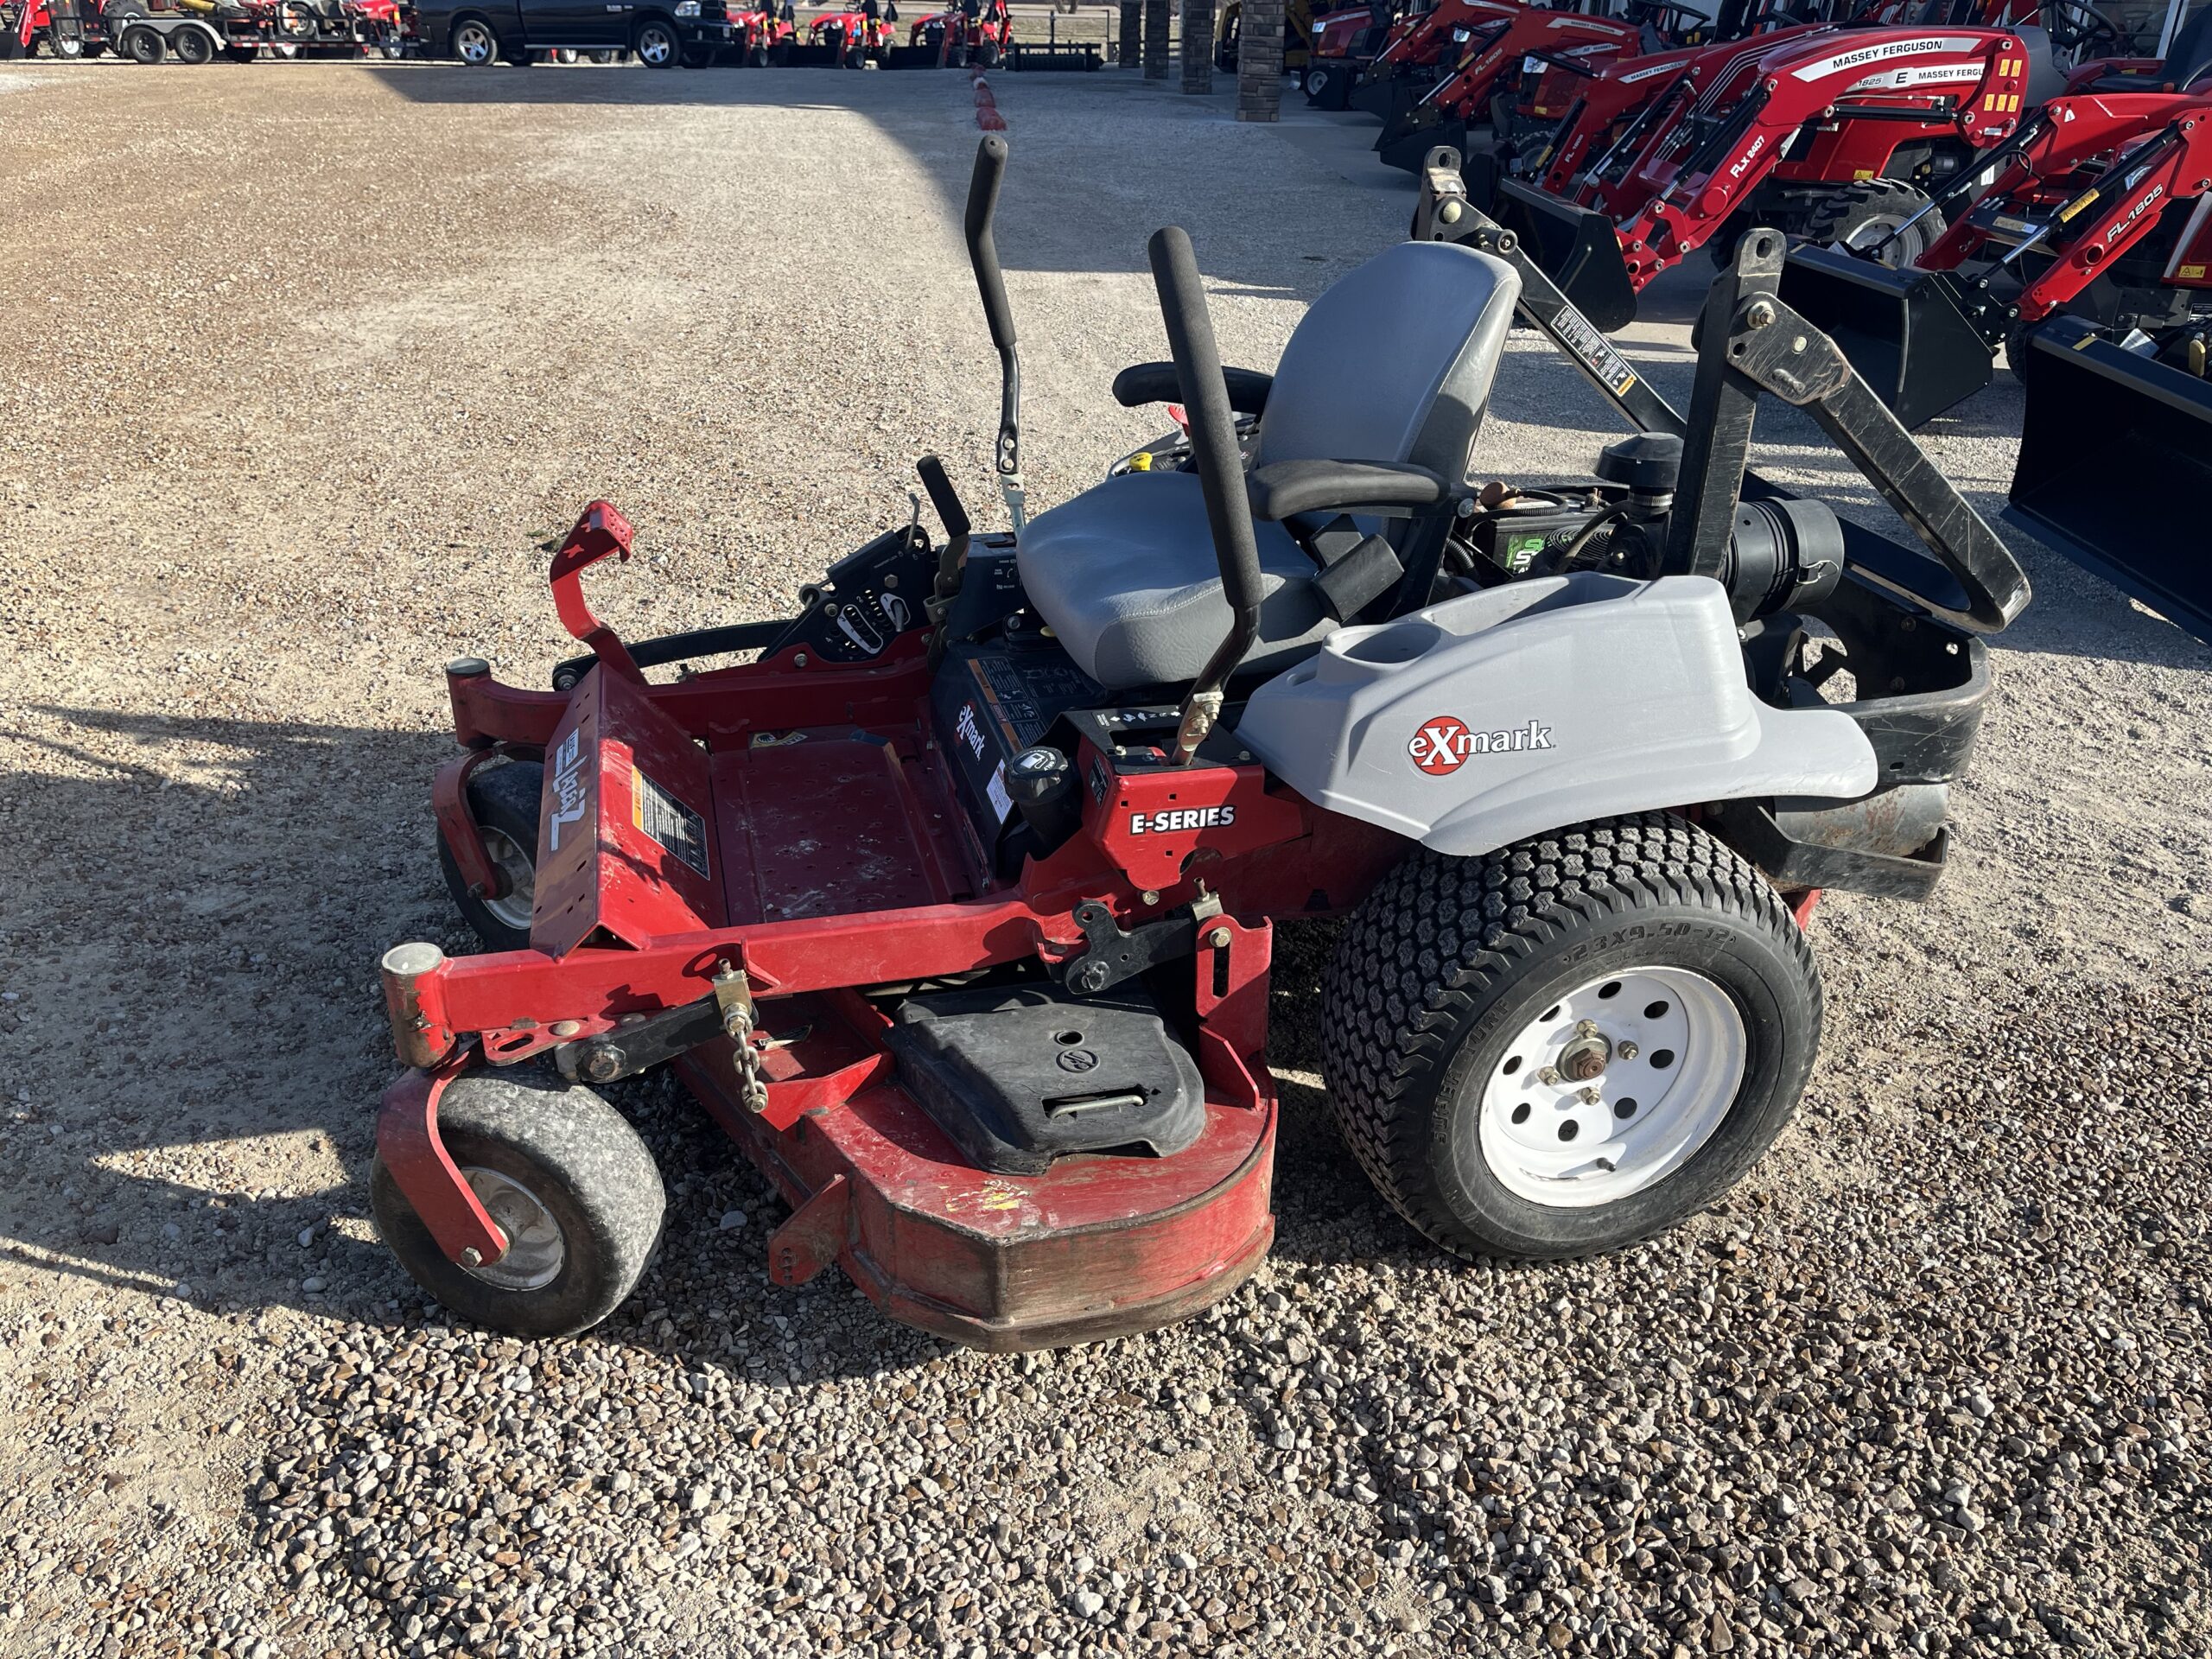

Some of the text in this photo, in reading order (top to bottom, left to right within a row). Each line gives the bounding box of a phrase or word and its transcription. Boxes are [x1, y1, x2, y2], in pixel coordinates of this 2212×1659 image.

[1833, 40, 1942, 69] MASSEY FERGUSON
[1630, 61, 1683, 80] MASSEY FERGUSON
[1858, 67, 1986, 87] 1825 E MASSEY FERGU
[1730, 135, 1765, 178] FLX 2407
[1130, 805, 1236, 835] E-SERIES
